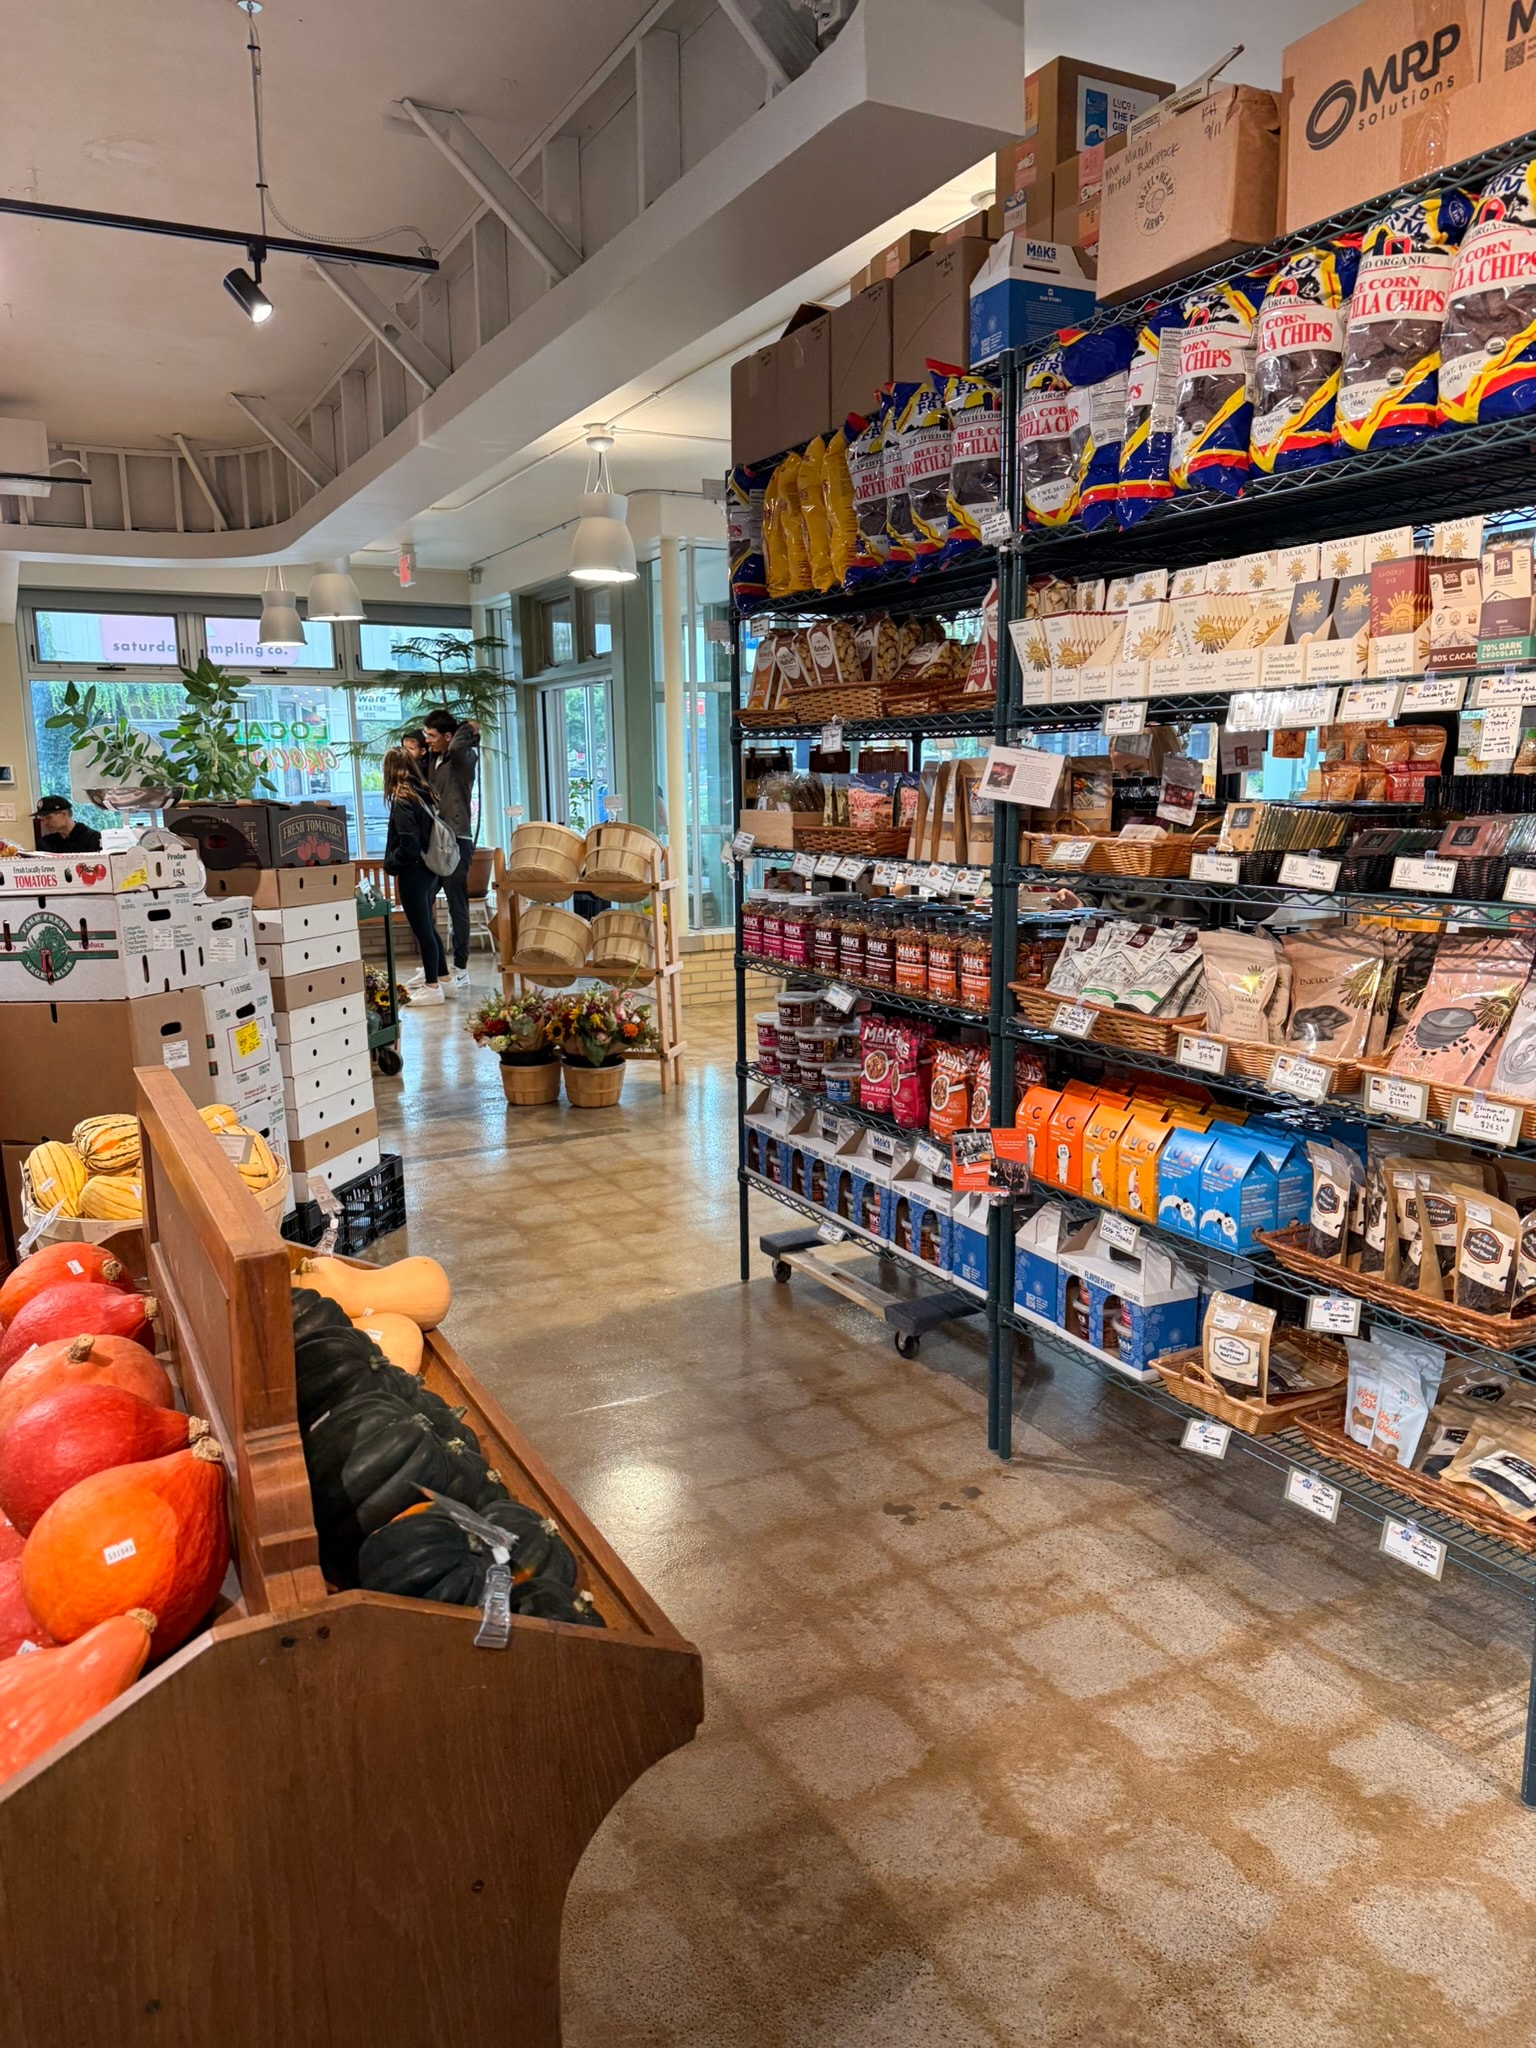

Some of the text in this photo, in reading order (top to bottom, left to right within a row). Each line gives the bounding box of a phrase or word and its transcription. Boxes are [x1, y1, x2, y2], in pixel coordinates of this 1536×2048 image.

[1359, 24, 1461, 112] MRP
[1358, 75, 1455, 130] solutions
[1113, 110, 1129, 122] THE
[1143, 211, 1165, 231] FARMS
[1465, 239, 1511, 264] CORN
[1375, 256, 1430, 267] ORGANIC
[1368, 275, 1421, 290] CORN
[1386, 288, 1446, 315] CHIPS
[1265, 313, 1307, 331] CORN
[1281, 322, 1333, 347] CHIPS
[1185, 350, 1233, 373] CHIPS
[957, 430, 986, 441] BLUE
[1439, 520, 1476, 533] INKAKAW
[1369, 531, 1404, 544] INKAKAW
[1325, 539, 1360, 551] INKAKAW
[267, 646, 289, 655] co.
[1499, 640, 1523, 650] DARK
[1432, 652, 1478, 663] 80% CACAO
[1481, 649, 1523, 658] CHOCOLATE
[283, 819, 342, 839] FRESH TOMATOES
[172, 868, 186, 878] USA
[13, 875, 58, 889] TOMATOES
[21, 913, 42, 933] FARM
[784, 921, 801, 935] MAKS
[815, 929, 832, 942] MAKS
[841, 935, 860, 949] MAKS
[867, 939, 888, 953] MAKS
[897, 944, 921, 959] MAKS
[929, 949, 950, 964] MAKS
[962, 954, 985, 970] MAKS
